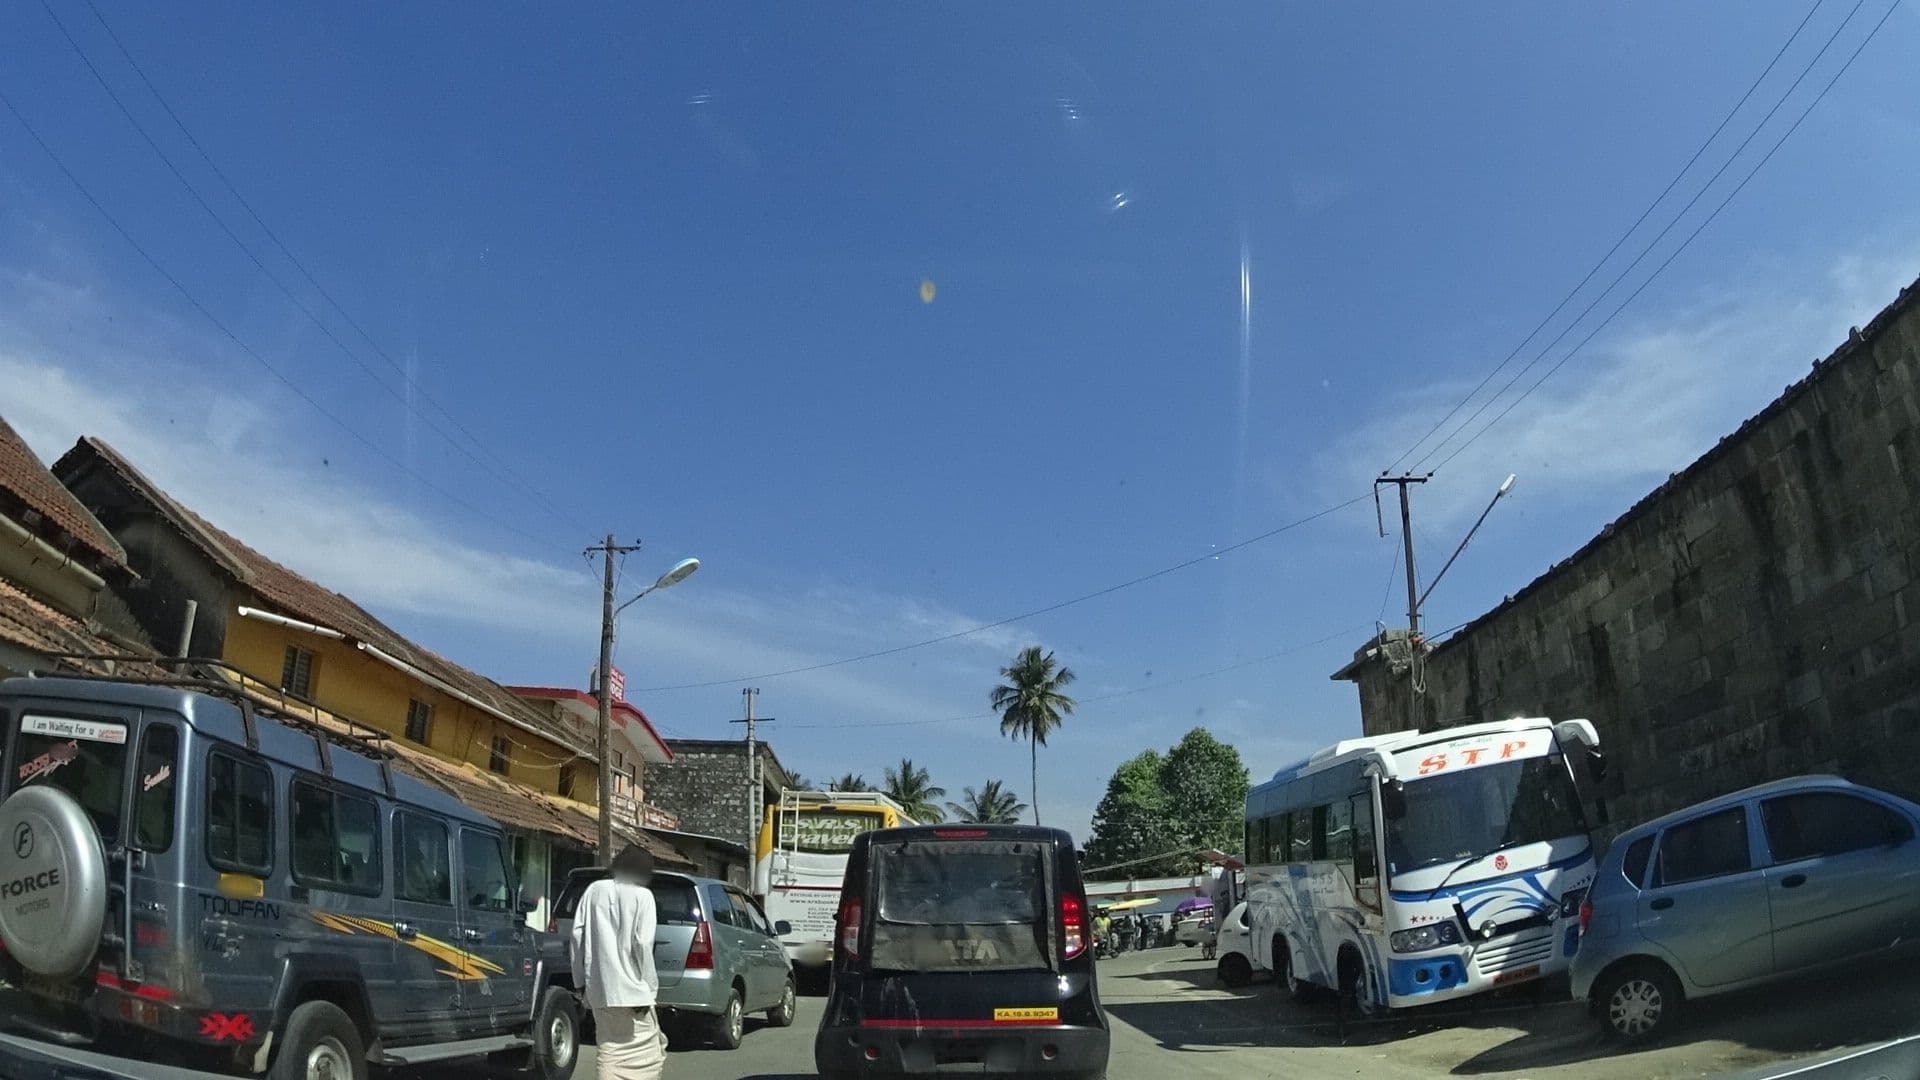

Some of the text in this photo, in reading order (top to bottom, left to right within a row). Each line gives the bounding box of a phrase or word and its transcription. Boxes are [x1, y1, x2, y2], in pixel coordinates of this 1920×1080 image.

[36, 721, 46, 730] am
[48, 719, 73, 734] Waiting
[75, 723, 87, 734] For
[0, 868, 60, 900] FORCE
[197, 892, 280, 921] TOOFAN
